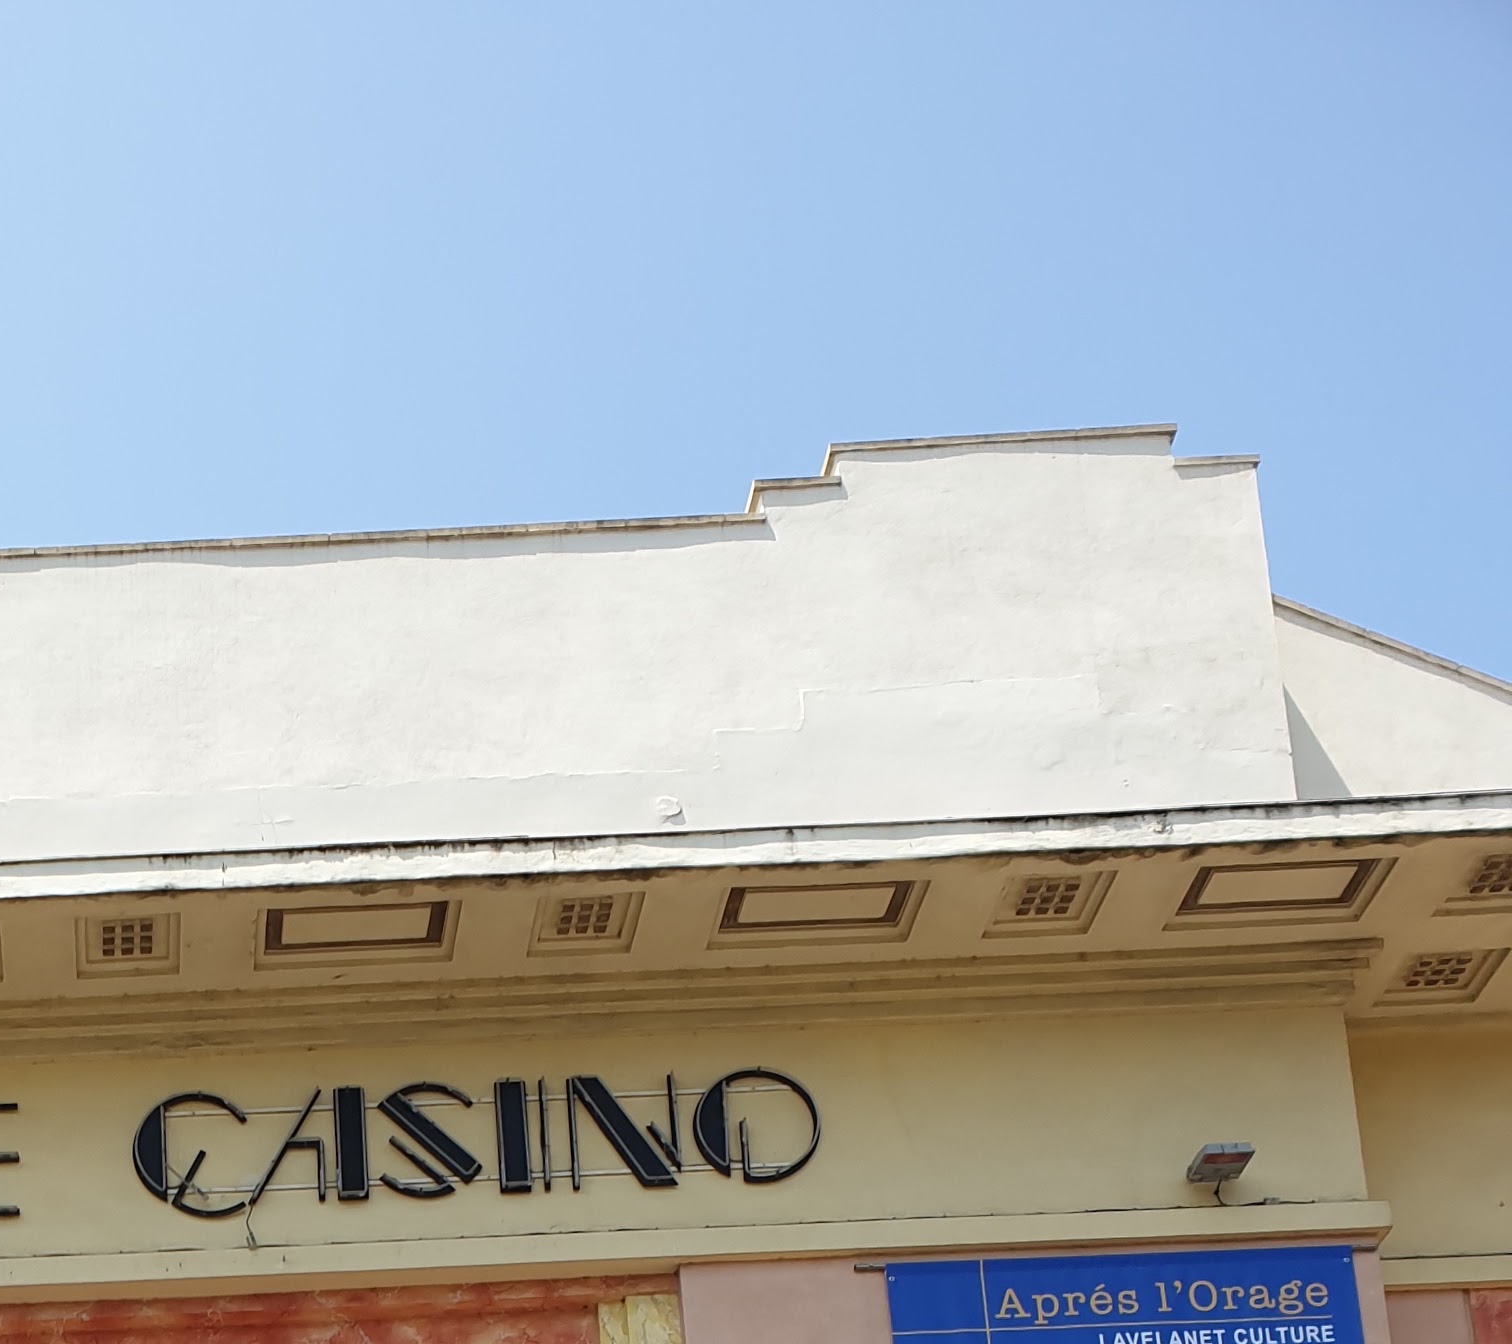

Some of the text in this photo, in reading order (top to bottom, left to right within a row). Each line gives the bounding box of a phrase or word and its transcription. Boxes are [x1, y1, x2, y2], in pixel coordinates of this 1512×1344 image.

[132, 1065, 821, 1218] CASINO
[995, 1280, 1330, 1324] Aprés l'Orage
[1234, 1325, 1335, 1344] CULTURE
